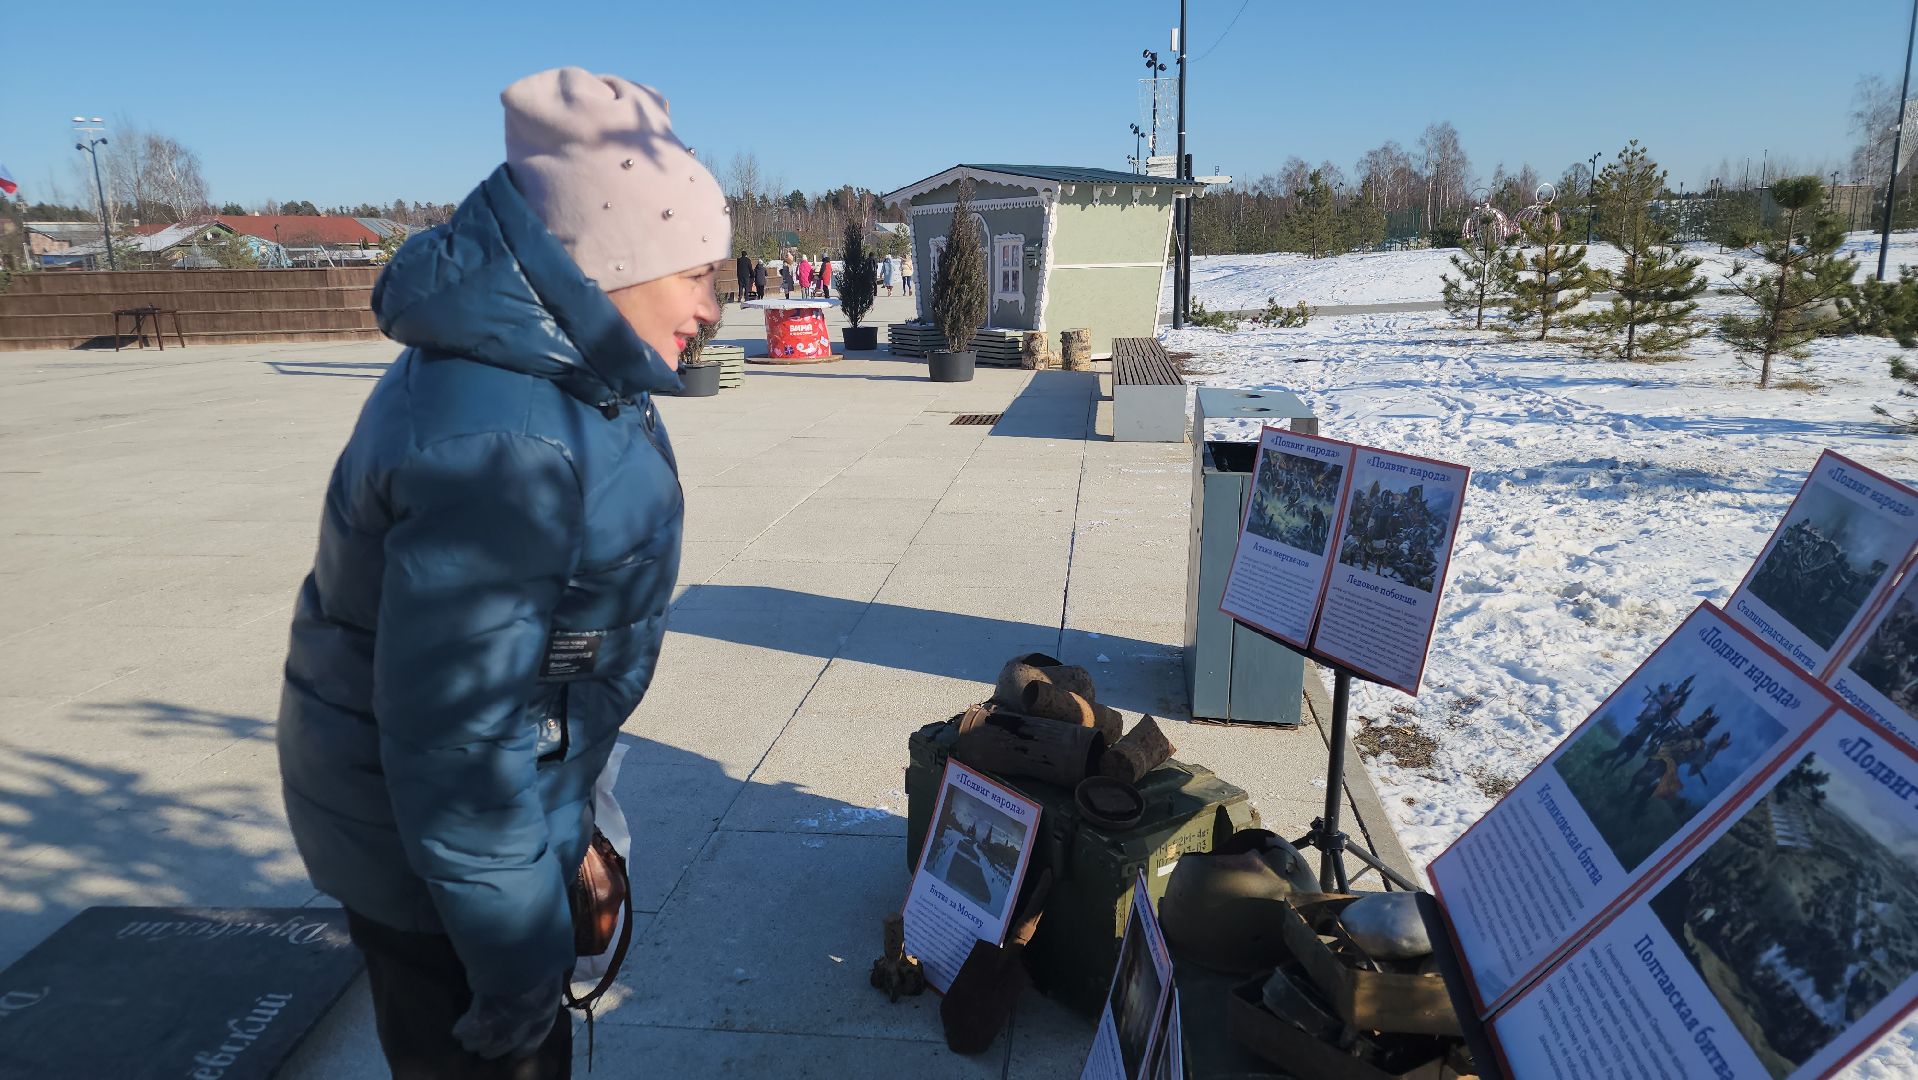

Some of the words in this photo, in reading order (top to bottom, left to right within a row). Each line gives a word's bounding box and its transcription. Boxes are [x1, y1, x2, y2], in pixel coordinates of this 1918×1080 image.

[1271, 436, 1304, 451] «Подвиг
[1306, 443, 1340, 458] народа»
[1367, 456, 1408, 473] «Подвиг
[1410, 467, 1451, 482] народа»
[1828, 467, 1871, 495] «Подвиг
[1870, 491, 1915, 516] народа»
[1347, 575, 1379, 592] Ледовое
[1380, 587, 1417, 606] побоище
[1737, 600, 1794, 652] Сталинградская
[1793, 644, 1816, 671] битва
[1699, 626, 1750, 669] «Подвиг
[1744, 664, 1801, 709] народа»
[957, 773, 990, 795] «Подвиг
[991, 792, 1025, 816] народа»
[1537, 783, 1583, 853] Куликовская
[1578, 847, 1603, 886] битва
[930, 884, 949, 904] Битва
[957, 902, 984, 928] Москву
[1634, 934, 1700, 1032] Полтавская
[1694, 1026, 1735, 1080] битва
